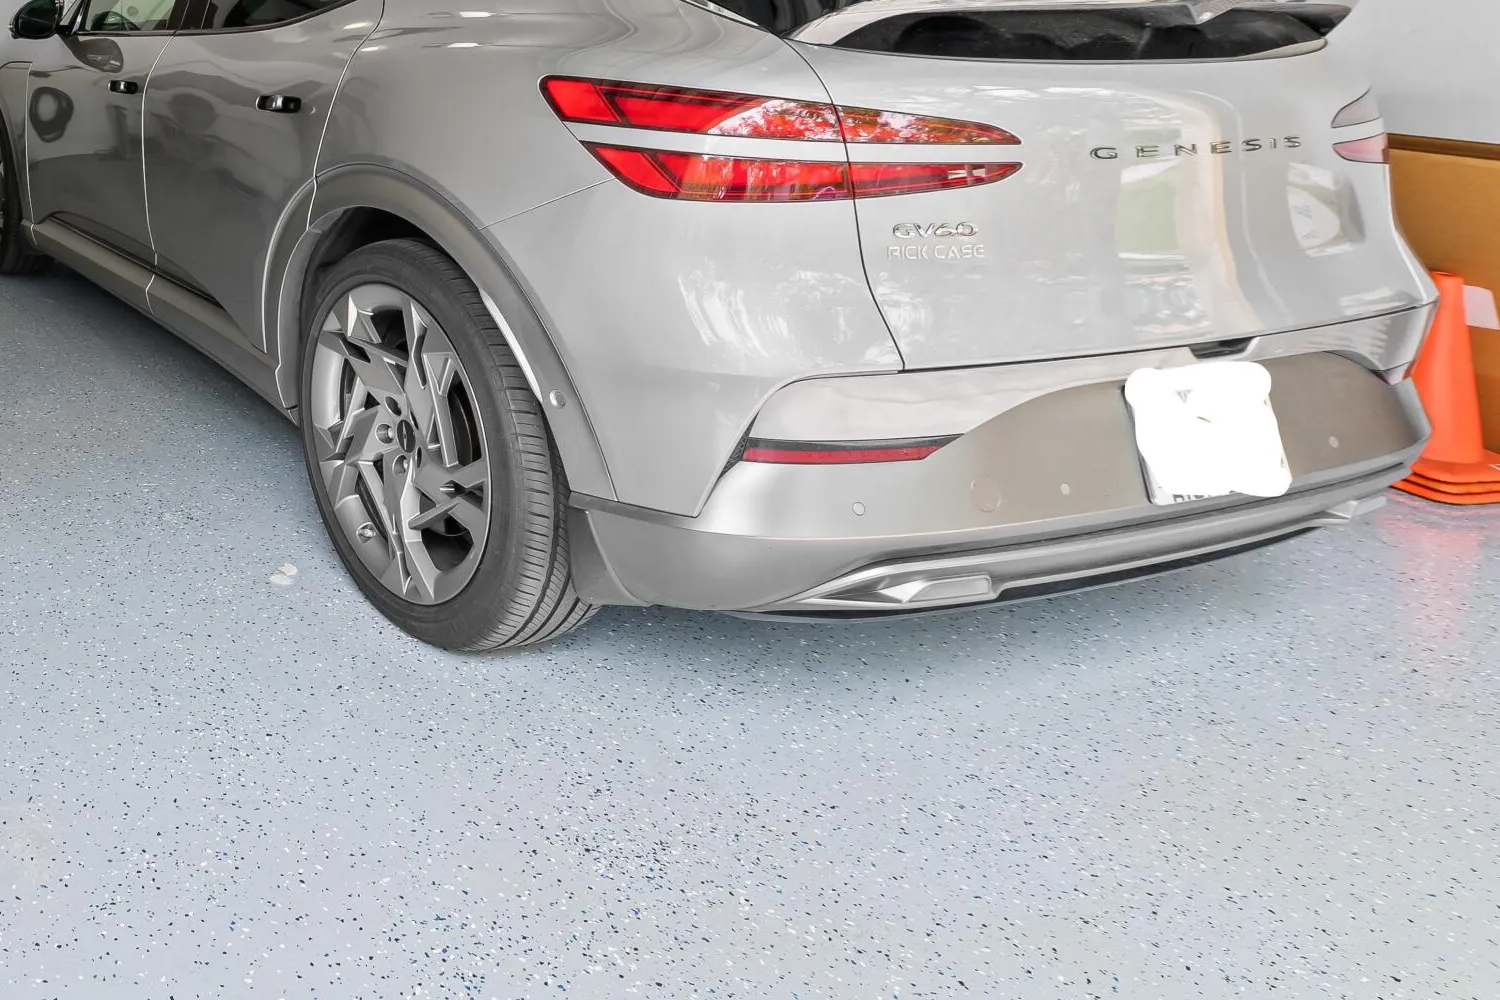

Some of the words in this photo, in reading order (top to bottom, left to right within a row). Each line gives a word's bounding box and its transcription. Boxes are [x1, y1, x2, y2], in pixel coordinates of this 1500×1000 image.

[1090, 135, 1302, 161] GENESIS
[892, 221, 979, 240] GV60
[886, 243, 928, 260] RICK
[933, 243, 986, 260] CASE
